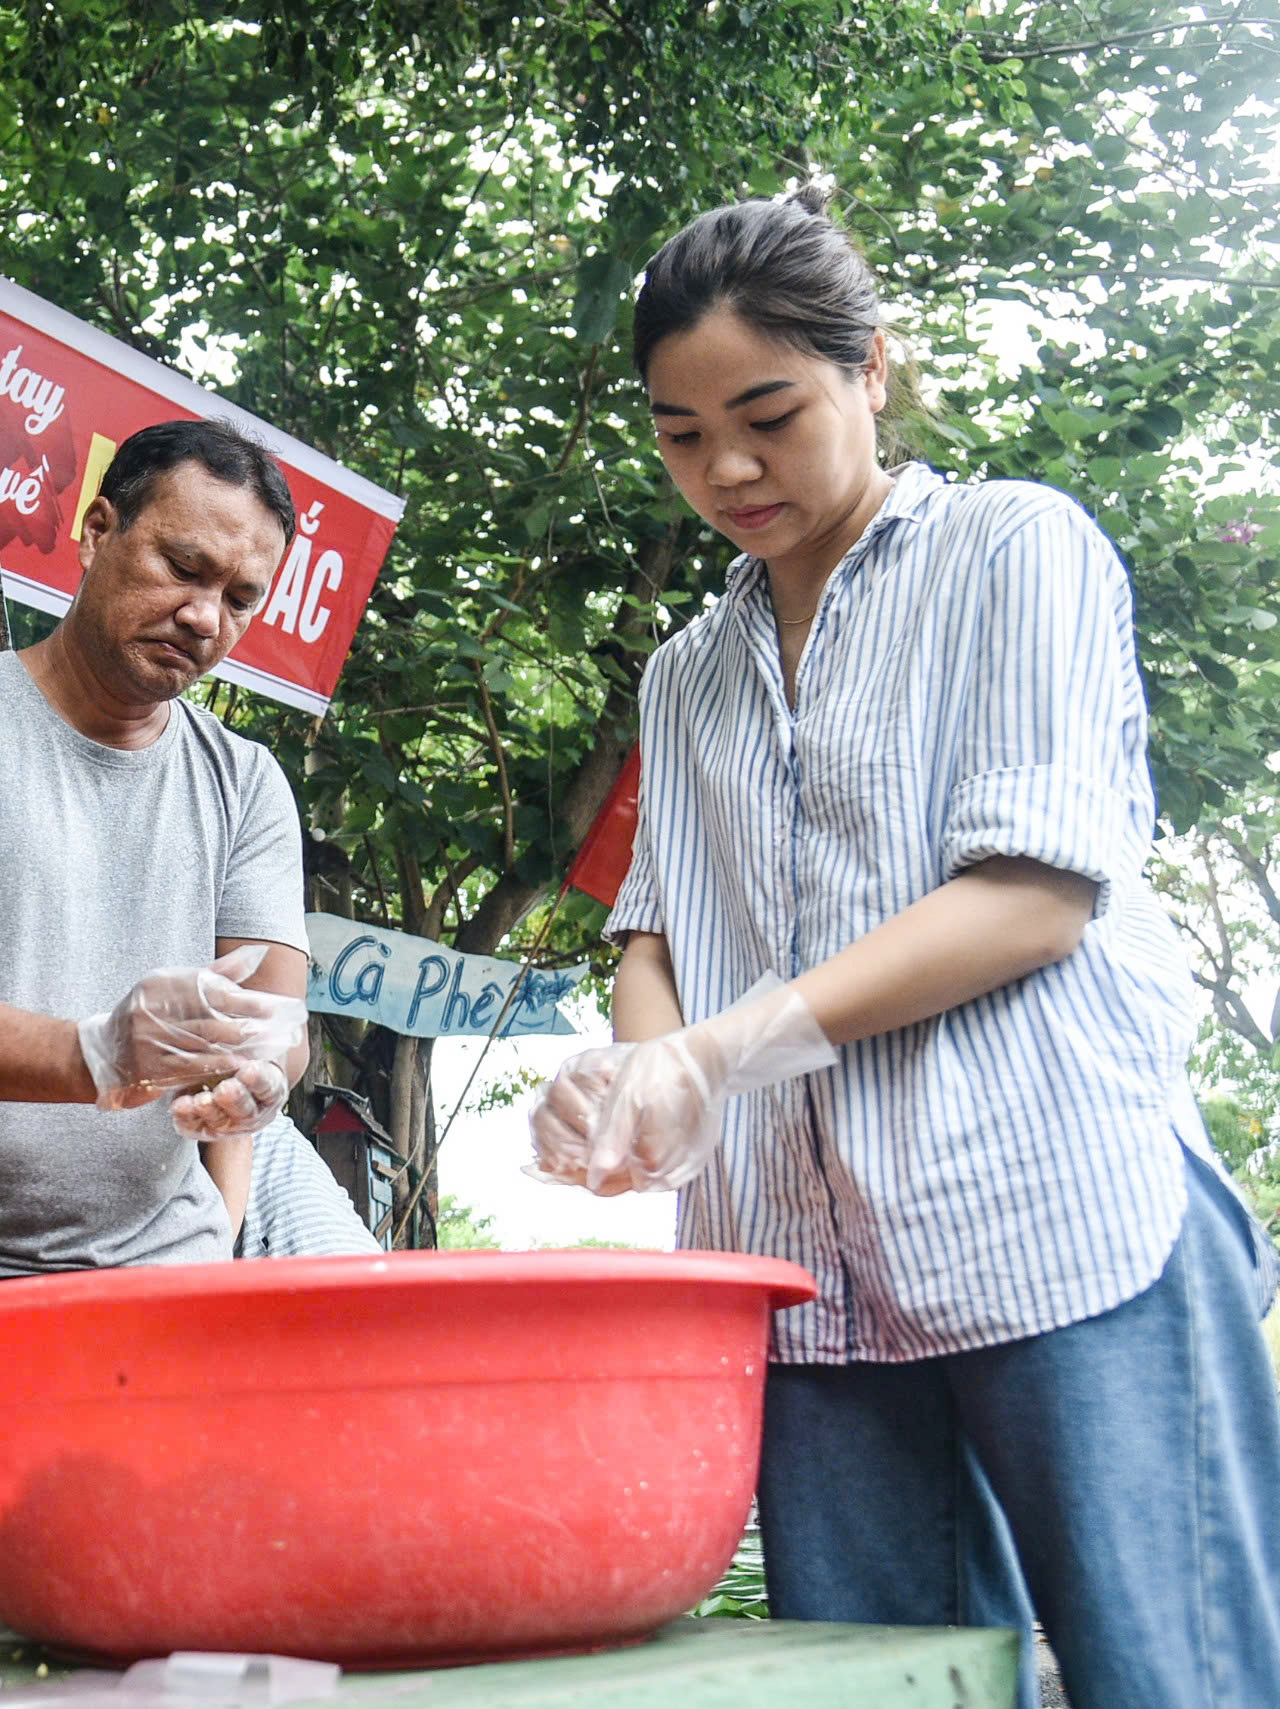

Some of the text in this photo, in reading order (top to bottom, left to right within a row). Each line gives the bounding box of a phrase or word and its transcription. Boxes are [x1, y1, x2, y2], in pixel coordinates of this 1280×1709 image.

[252, 500, 345, 645] ẮC
[328, 934, 505, 1033] Cà Phê
